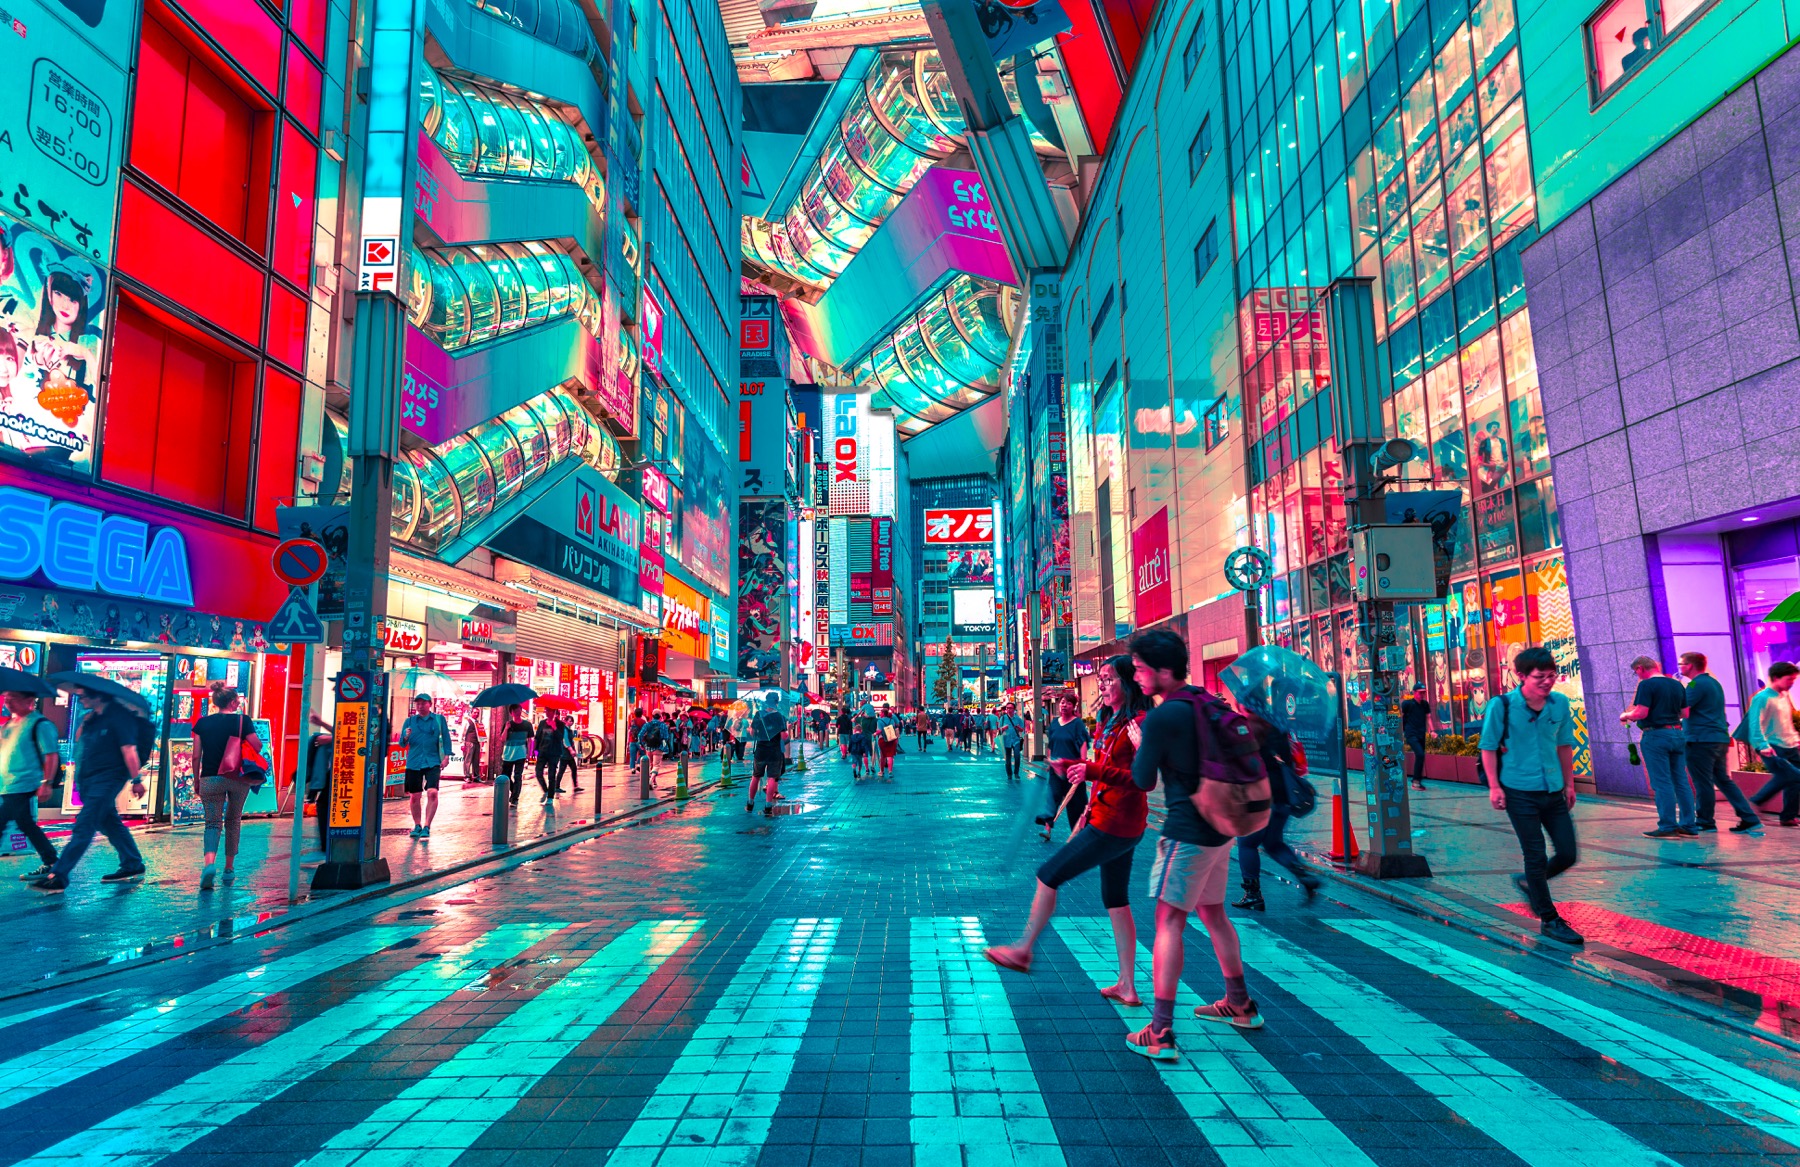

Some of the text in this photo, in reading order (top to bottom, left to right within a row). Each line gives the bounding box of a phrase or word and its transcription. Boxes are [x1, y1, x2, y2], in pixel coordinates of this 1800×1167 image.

[43, 83, 101, 138] 16:00
[48, 69, 101, 118] 営業時間
[36, 126, 100, 179] 翌5:00
[403, 401, 427, 427] メラ
[404, 373, 438, 409] カメラ
[599, 494, 638, 550] LABI
[0, 486, 194, 606] SEGA
[562, 545, 610, 590] パソコン館
[597, 536, 638, 569] AKIHABARA
[878, 521, 891, 571] Duty Free
[1138, 547, 1161, 593] atré
[471, 621, 493, 638] LABI
[338, 711, 358, 823] 路上喫煙禁止です。
[391, 750, 407, 762] au
